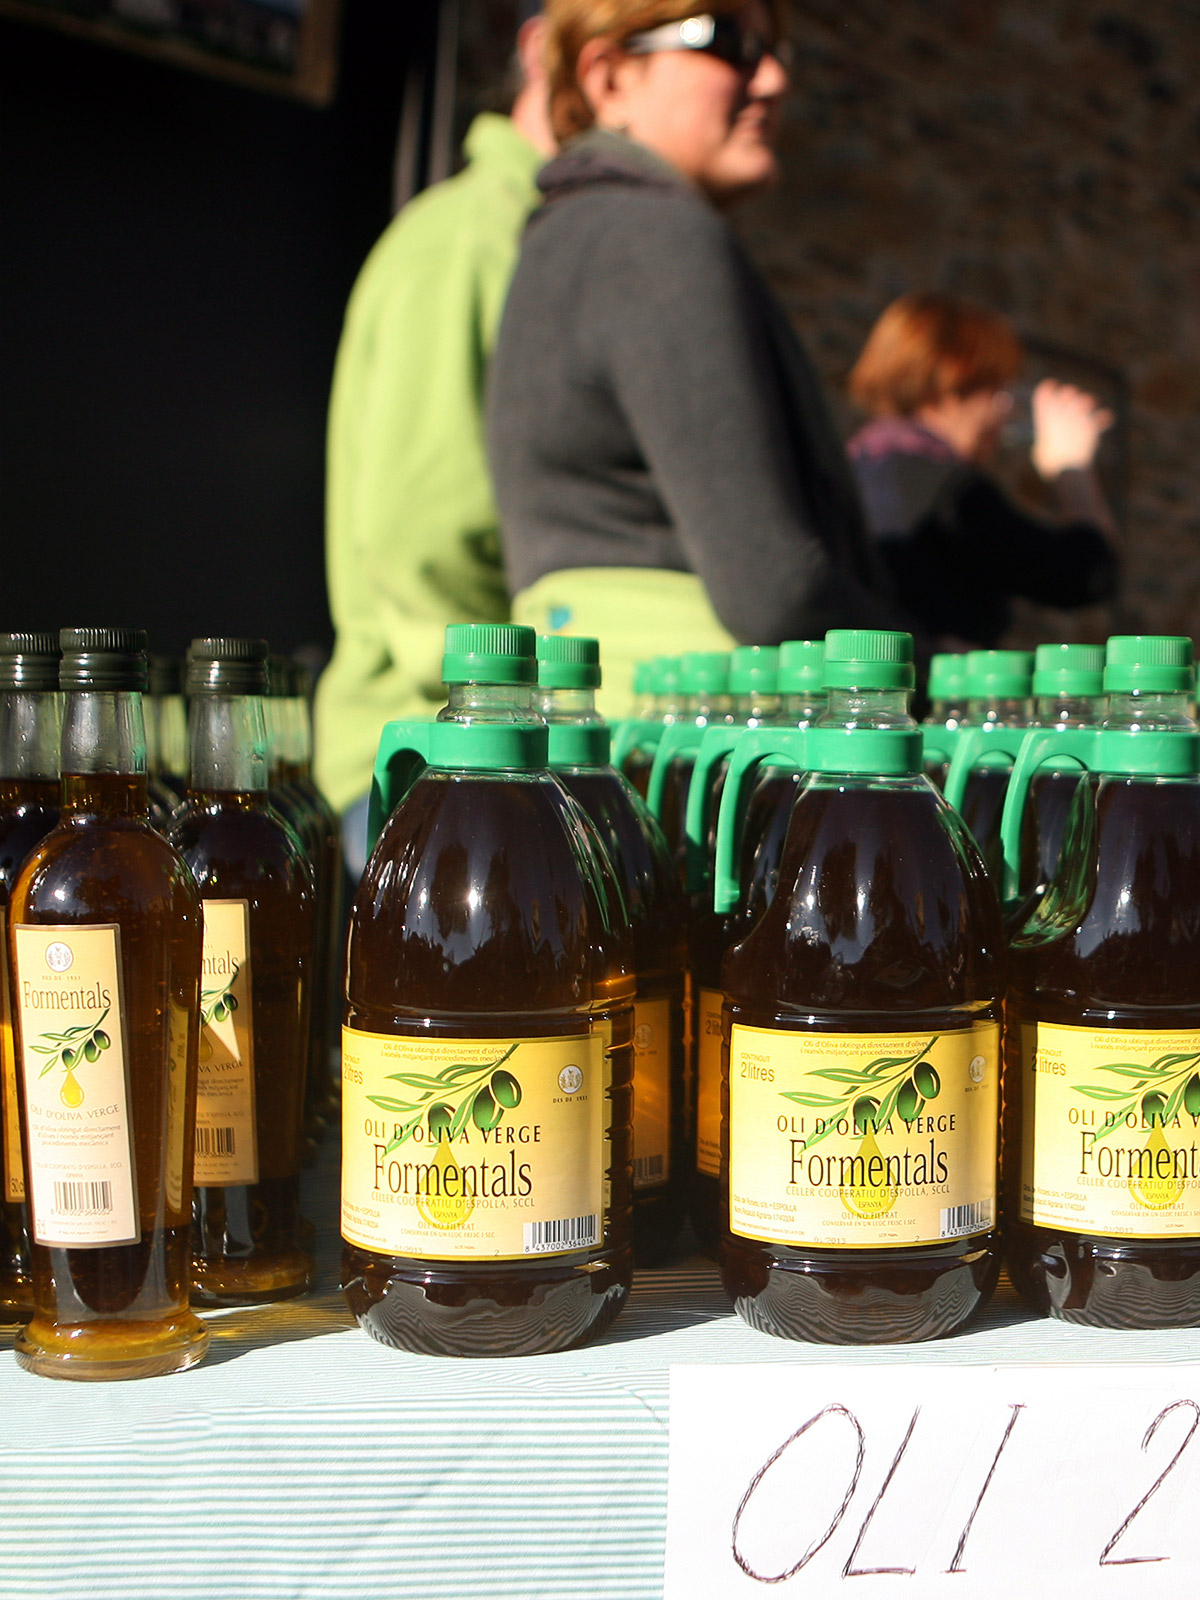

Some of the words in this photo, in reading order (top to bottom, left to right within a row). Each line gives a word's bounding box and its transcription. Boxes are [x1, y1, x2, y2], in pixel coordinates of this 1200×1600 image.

[23, 981, 111, 1010] Formentals
[1039, 1056, 1066, 1075] litres
[46, 1110, 83, 1120] D'OLIVA
[87, 1104, 120, 1119] VERGE
[1068, 1108, 1095, 1125] OLI
[1105, 1110, 1181, 1129] D'OLIVA
[364, 1118, 385, 1138] OLI
[394, 1123, 470, 1144] D'OLIVA
[481, 1125, 541, 1144] VERGE
[777, 1115, 805, 1133] OLI
[815, 1117, 894, 1135] D'OLIVA
[906, 1114, 956, 1134] VERGE
[374, 1143, 532, 1198] Formentals
[790, 1138, 948, 1187] Formentals
[786, 1186, 814, 1196] CELLER
[818, 1186, 877, 1198] COOPERATIU
[932, 1184, 950, 1195] SCCL
[1076, 1176, 1104, 1188] CELLER
[1108, 1178, 1163, 1190] COOPERATIU
[372, 1191, 394, 1203] CELLER
[397, 1193, 450, 1208] COOPERATIU
[513, 1197, 535, 1208] SCCL
[434, 1211, 458, 1219] ESPANYA
[535, 1242, 565, 1251] 437002
[732, 1402, 1027, 1585] OLI
